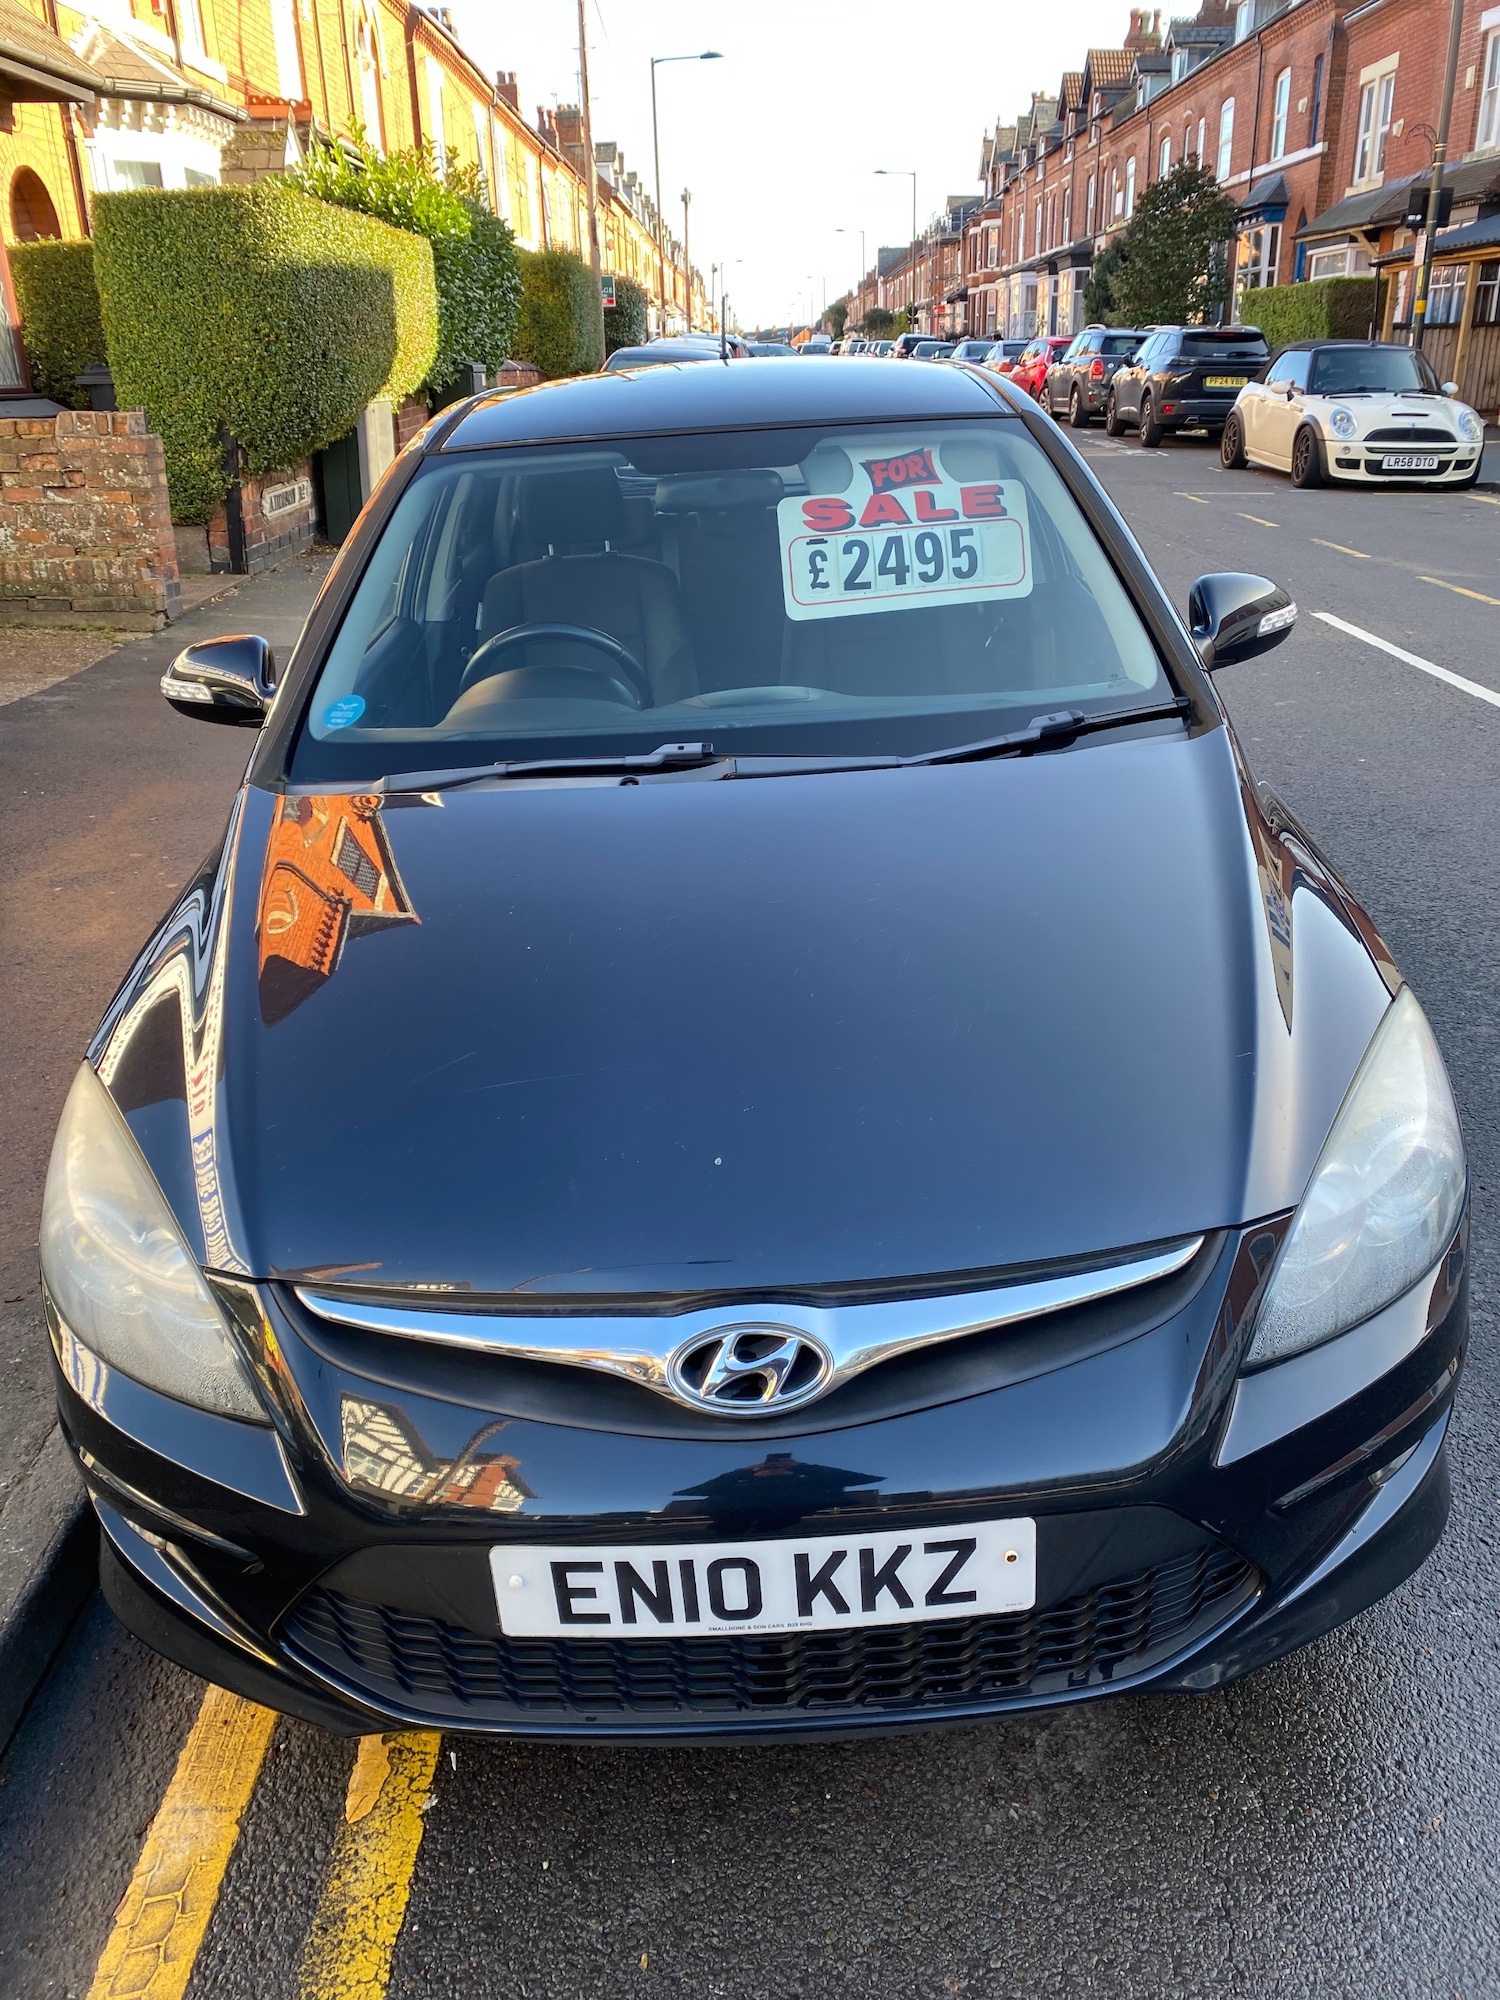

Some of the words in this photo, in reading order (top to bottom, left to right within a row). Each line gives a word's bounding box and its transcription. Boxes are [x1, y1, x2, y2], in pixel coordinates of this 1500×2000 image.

[1209, 377, 1229, 385] PF24
[872, 454, 926, 487] FOR
[1387, 457, 1413, 467] LR58
[1415, 457, 1435, 467] DTO
[801, 484, 1008, 532] SALE
[808, 528, 978, 591] £2495
[550, 1556, 763, 1625] EN10
[793, 1537, 977, 1618] KKZ
